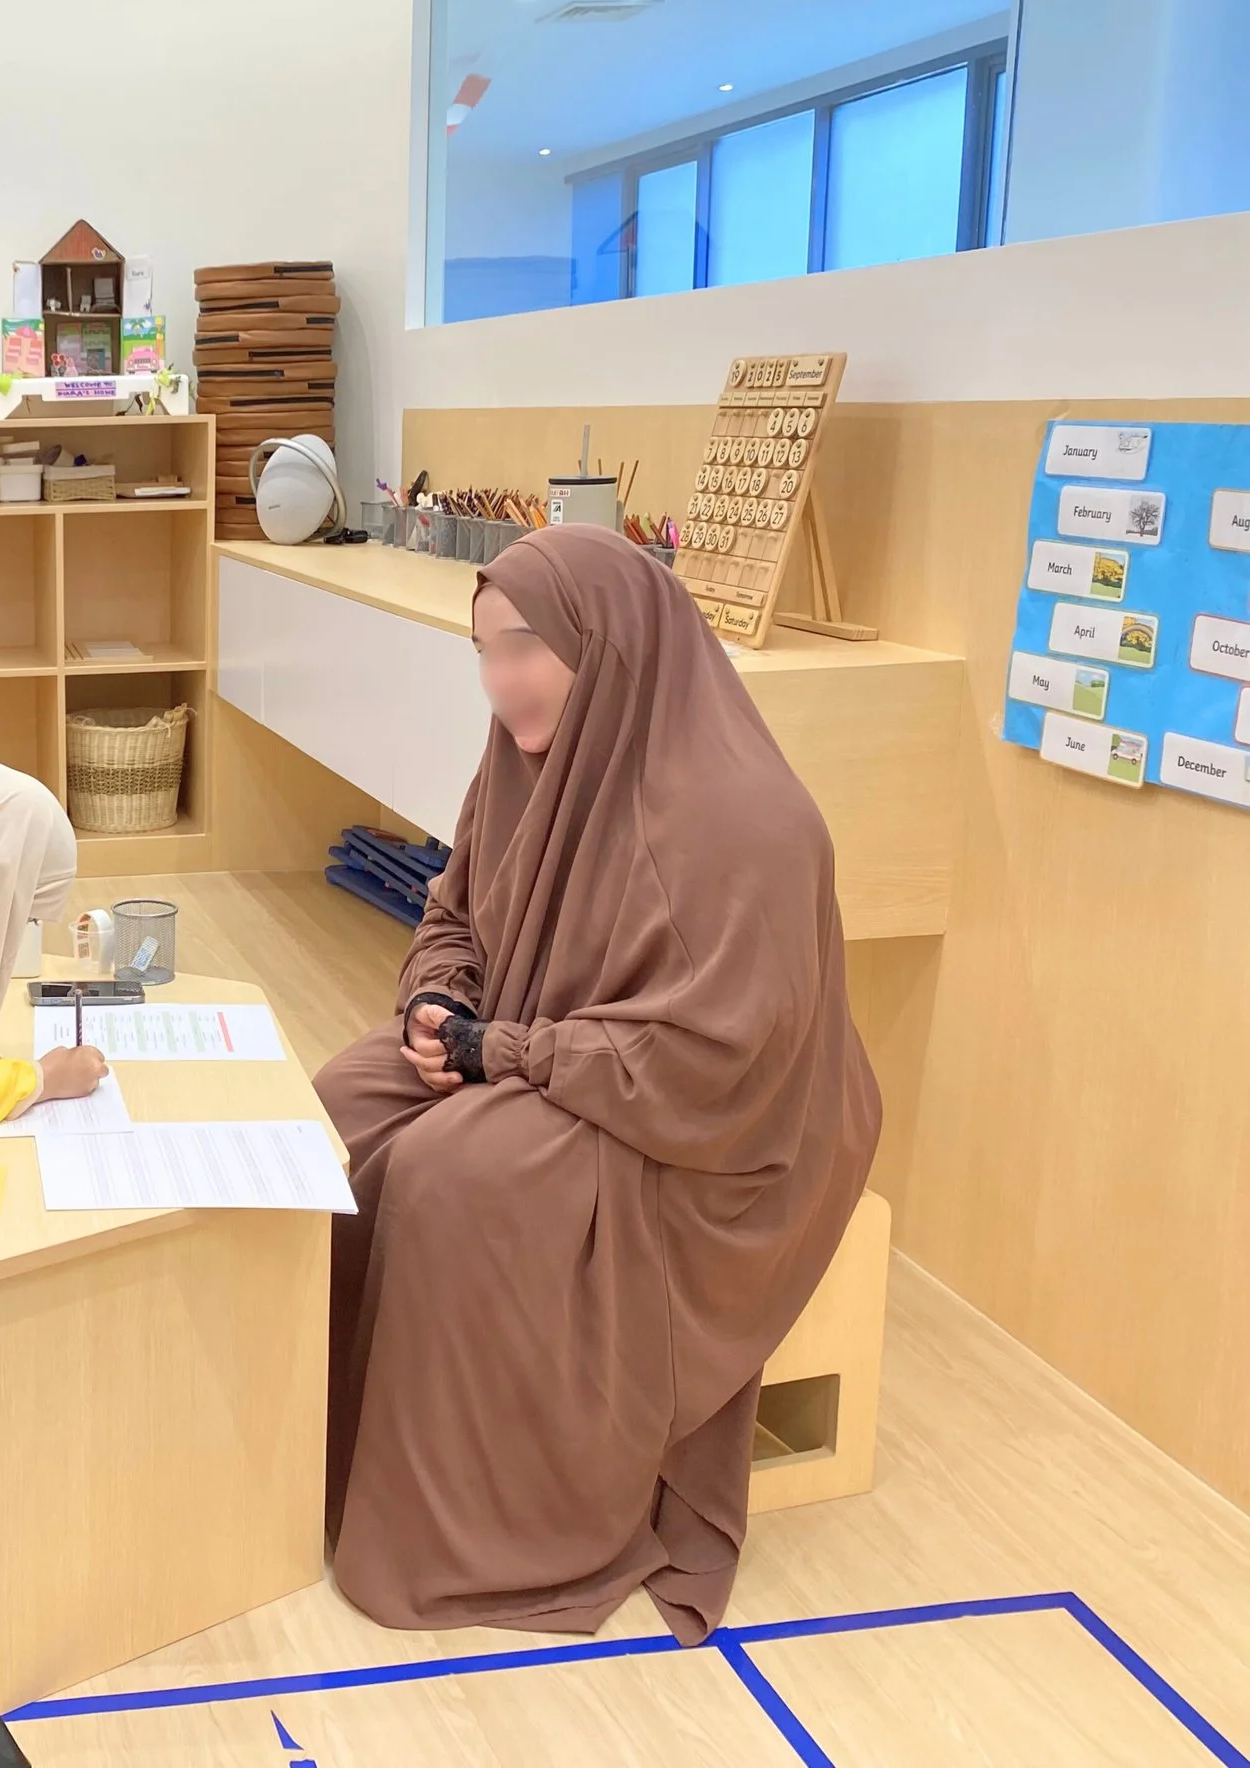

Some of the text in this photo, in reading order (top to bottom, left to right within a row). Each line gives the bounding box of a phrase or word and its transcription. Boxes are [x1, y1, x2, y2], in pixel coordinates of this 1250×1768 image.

[731, 370, 740, 383] 19
[789, 369, 823, 381] September
[770, 420, 808, 433] 4 5 6
[707, 447, 801, 463] 7 8 9 10 11 12 13
[1063, 444, 1098, 460] January
[698, 475, 793, 494] 14 15 16 17 18 20
[689, 503, 783, 525] 21 22 23 24 25 26 27
[1073, 505, 1112, 523] February
[680, 530, 730, 548] 28 29 30 31
[1047, 562, 1072, 576] March
[724, 615, 750, 630] Saturday
[1073, 625, 1095, 639] April
[1212, 640, 1250, 659] October
[1032, 675, 1050, 691] May
[1065, 737, 1086, 752] June
[1177, 755, 1227, 779] December
